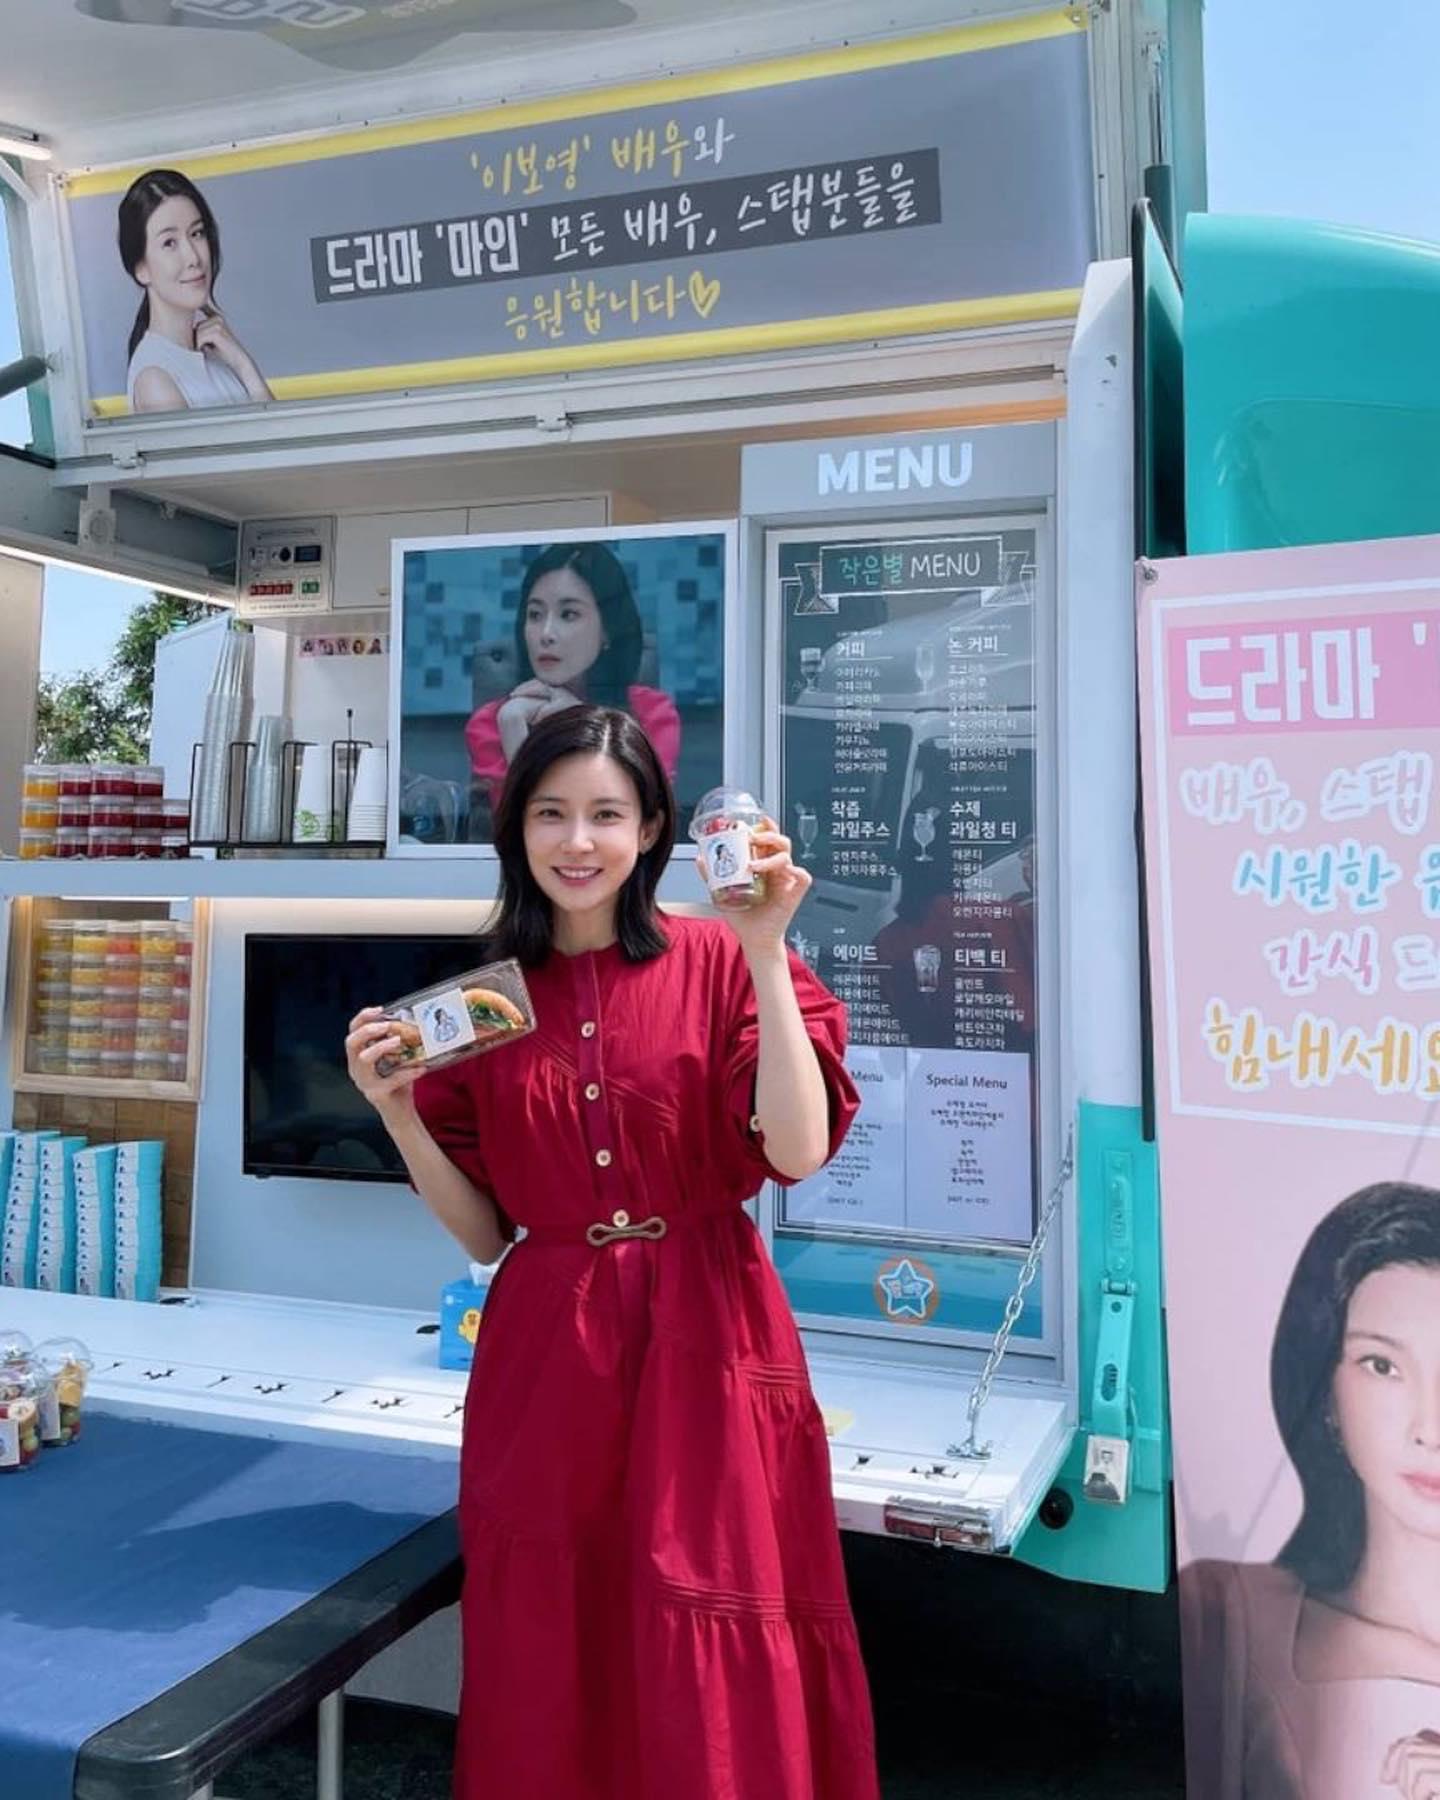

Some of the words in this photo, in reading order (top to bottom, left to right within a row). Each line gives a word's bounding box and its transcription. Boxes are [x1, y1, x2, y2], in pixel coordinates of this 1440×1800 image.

[471, 134, 591, 195] '이보영'
[611, 117, 736, 179] 배우와
[326, 229, 422, 294] 드라마
[436, 212, 529, 277] '마인'
[551, 211, 606, 262] 모든
[624, 191, 717, 250] 배우,
[737, 161, 918, 236] 스탭분들을
[505, 276, 686, 341] 응원합니다
[818, 442, 974, 496] MENU
[840, 553, 903, 587] 작은별
[910, 551, 981, 579] MENU
[836, 639, 866, 658] 커피
[947, 637, 963, 654] 논
[967, 634, 998, 653] 커피
[1186, 627, 1380, 726] 드라마
[1182, 759, 1306, 834] 배우,
[1322, 753, 1432, 833] 스탭
[831, 800, 860, 818] 착즙
[949, 800, 981, 818] 수제
[831, 820, 891, 839] 과일주스
[949, 820, 996, 839] 과일청
[1001, 820, 1016, 839] 티
[1237, 844, 1396, 908] 시원한
[832, 944, 878, 961] 에이드
[955, 948, 986, 967] 티백
[991, 949, 1006, 968] 티
[1268, 931, 1371, 990] 간식
[851, 1071, 884, 1083] Menu
[926, 1073, 969, 1088] Special
[972, 1076, 1008, 1090] Menu
